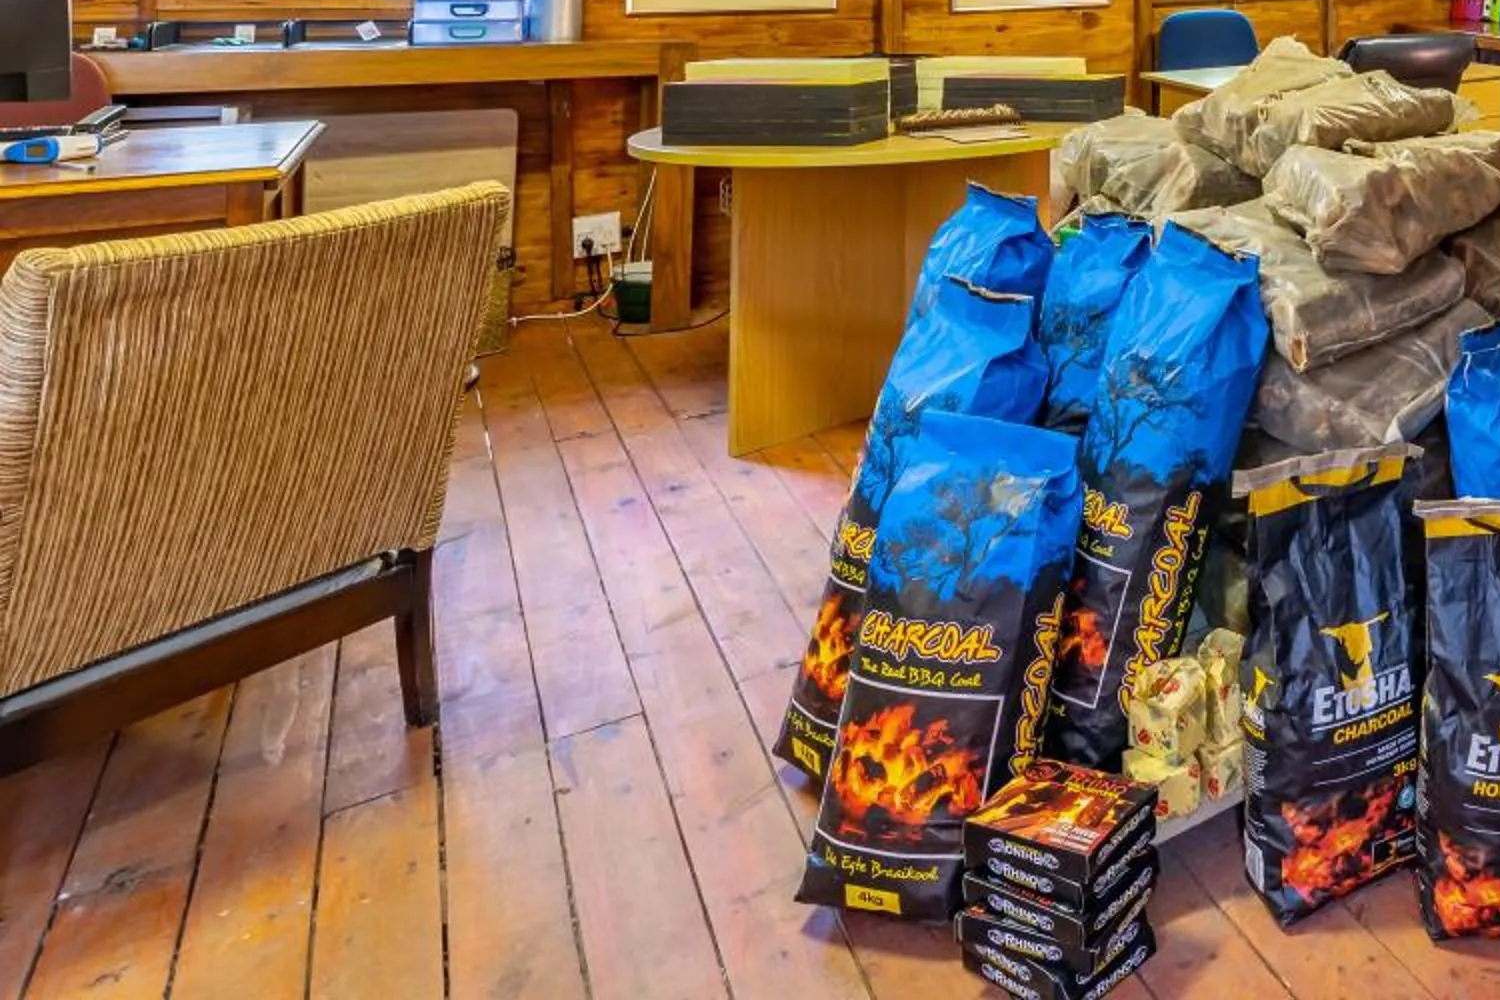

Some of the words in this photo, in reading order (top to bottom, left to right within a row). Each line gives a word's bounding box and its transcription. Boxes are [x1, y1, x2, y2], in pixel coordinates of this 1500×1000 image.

[860, 609, 1003, 664] CHARCOAL
[861, 656, 878, 673] The
[880, 660, 906, 679] Real
[908, 666, 945, 687] BBQ
[950, 671, 982, 687] Coal
[1333, 702, 1414, 744] CHARCOAL
[1393, 758, 1417, 777] 3kg
